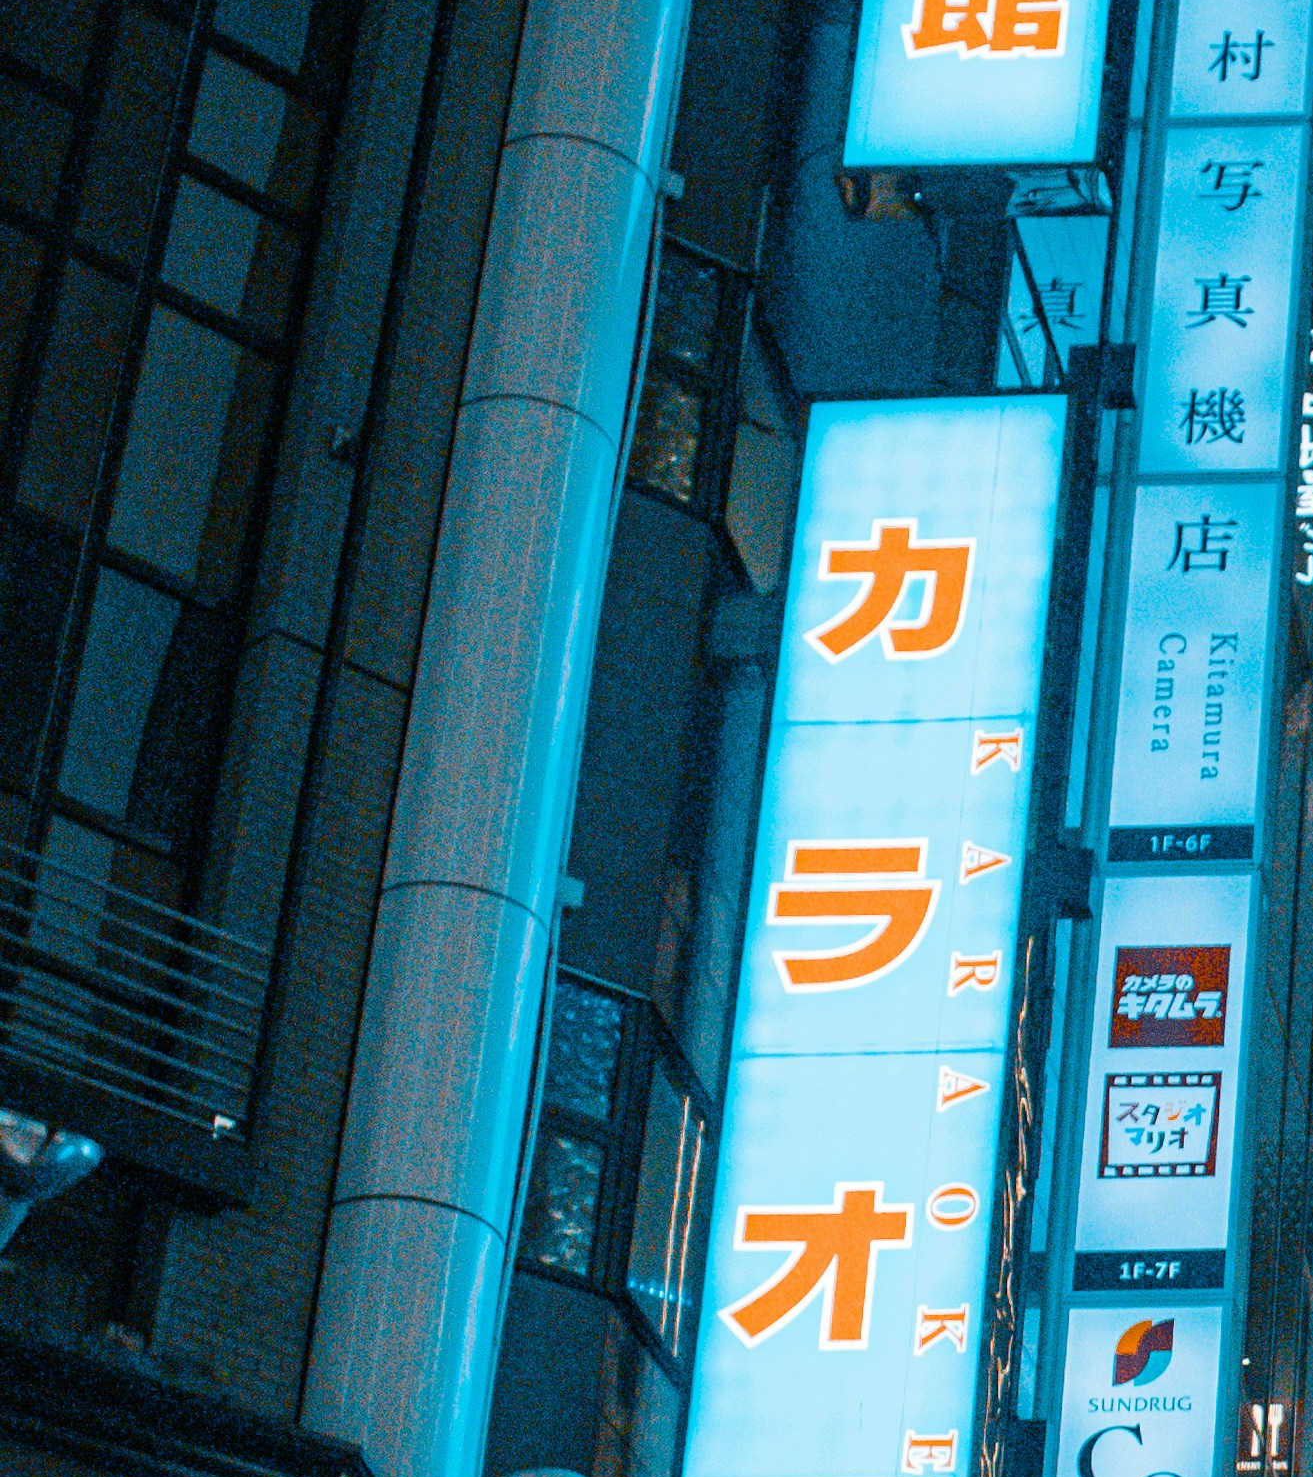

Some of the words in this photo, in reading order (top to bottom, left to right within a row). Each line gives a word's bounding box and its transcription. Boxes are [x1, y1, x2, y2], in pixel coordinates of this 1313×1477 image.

[1150, 634, 1187, 755] Camera
[1208, 632, 1240, 783] Kitamura
[1148, 831, 1211, 853] 1F-6F
[1124, 972, 1195, 996] カメラの
[1116, 990, 1224, 1022] キタムラ
[1116, 1100, 1209, 1128] スタジオ
[1124, 1127, 1191, 1156] マリオ
[1118, 1261, 1182, 1281] 1F-7F
[1087, 1395, 1193, 1414] SUNDRUG
